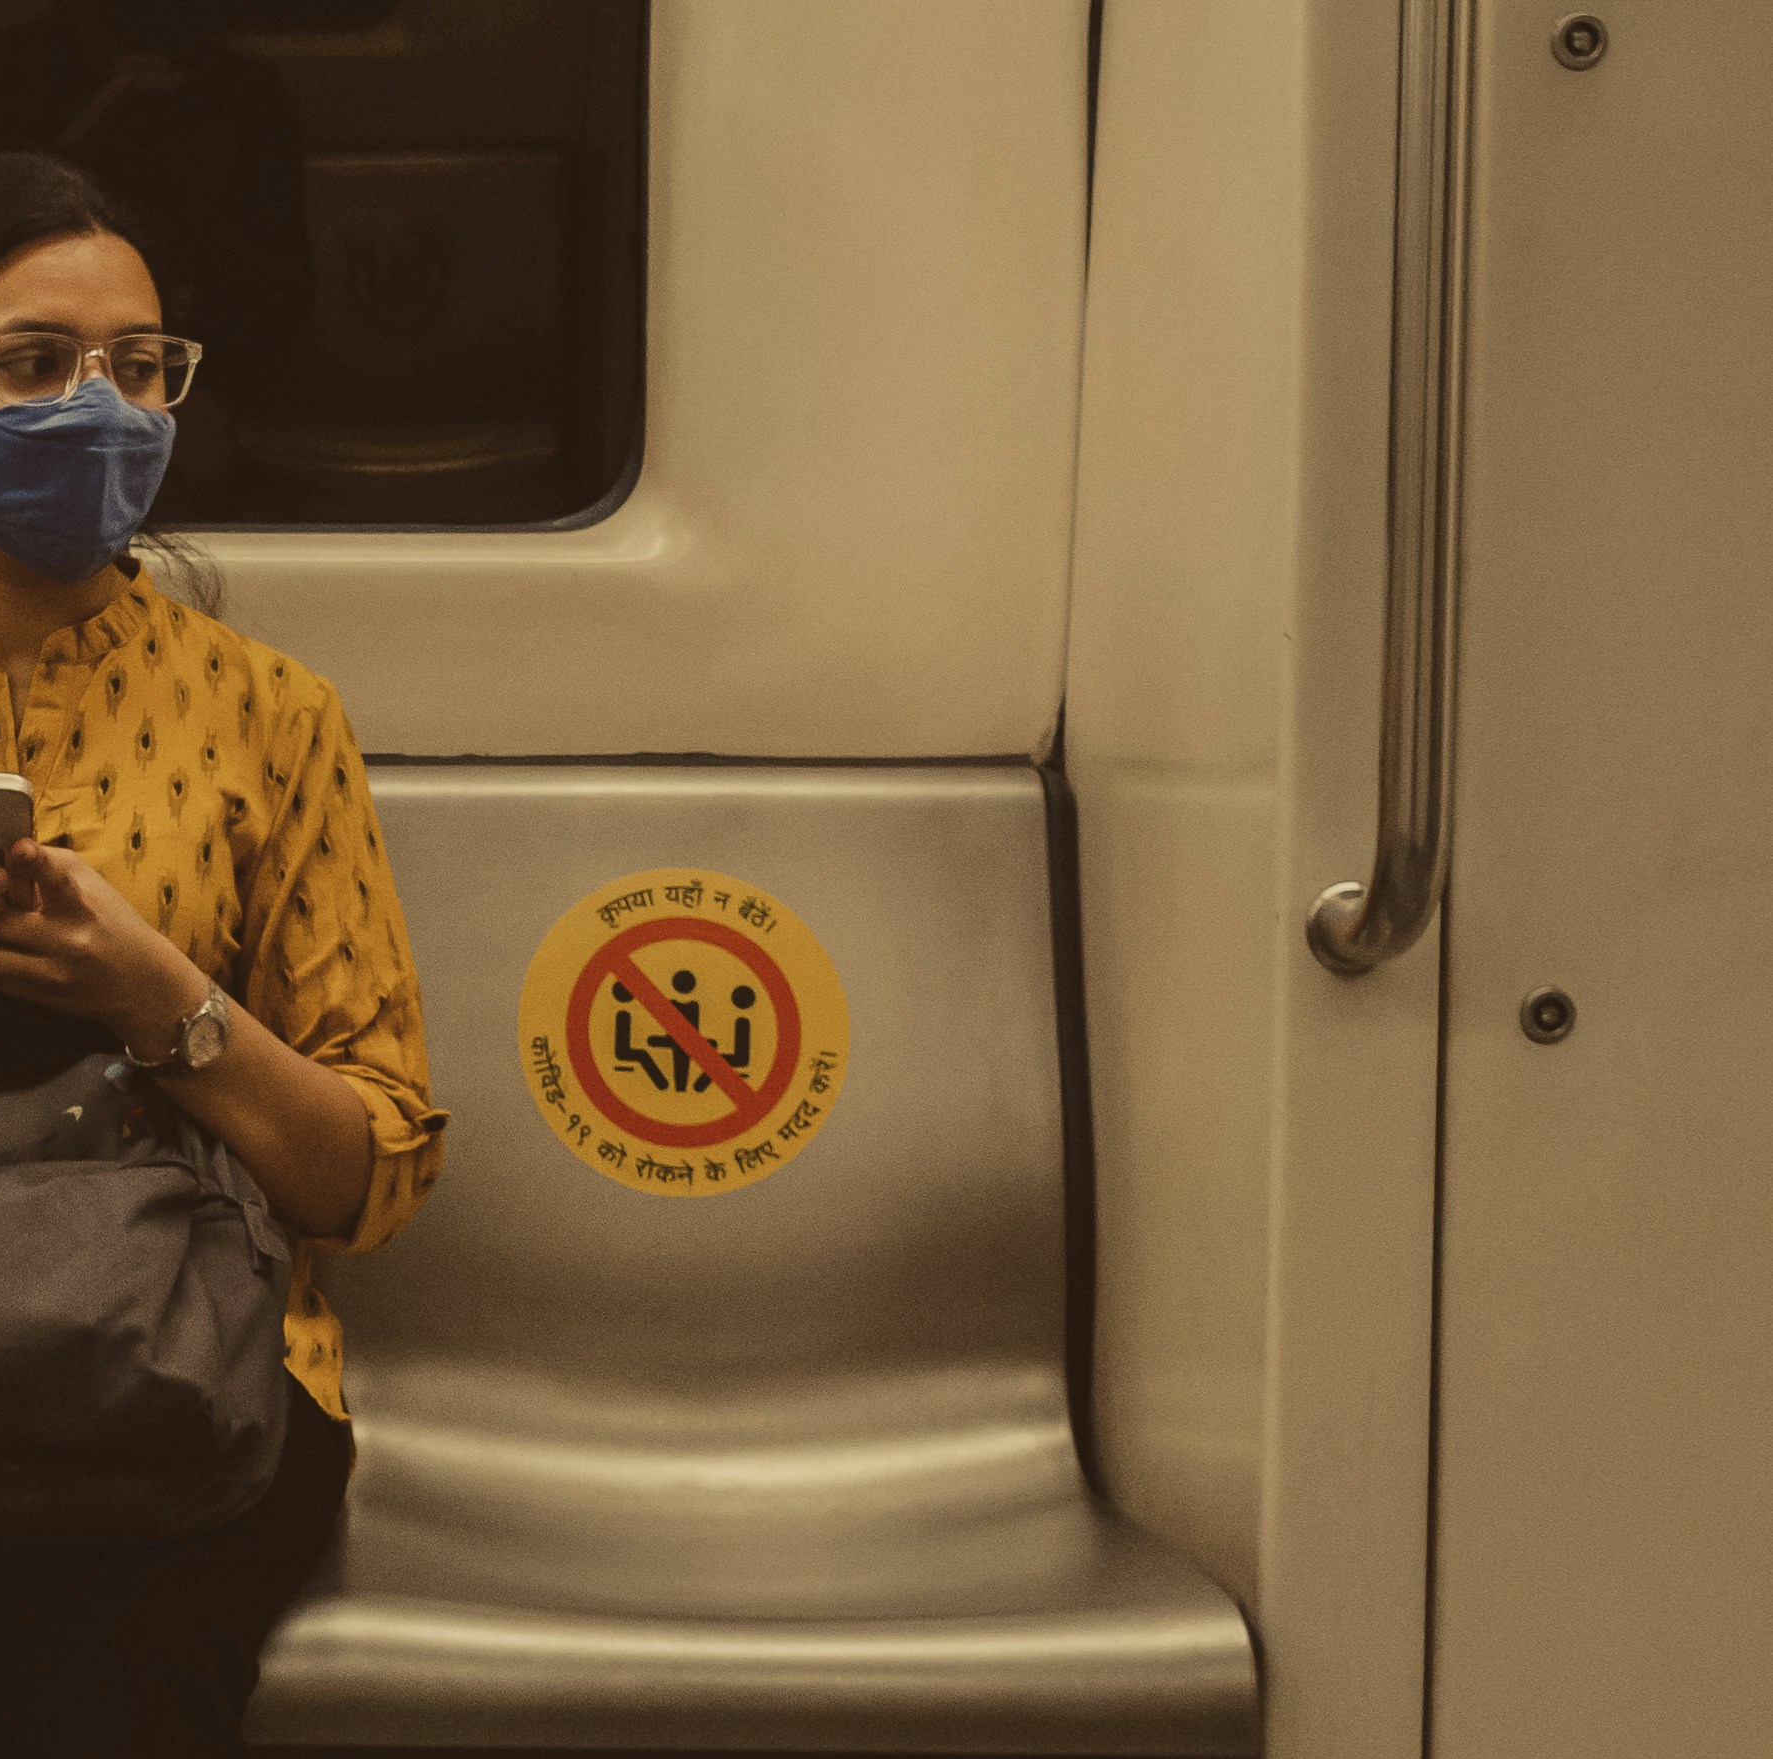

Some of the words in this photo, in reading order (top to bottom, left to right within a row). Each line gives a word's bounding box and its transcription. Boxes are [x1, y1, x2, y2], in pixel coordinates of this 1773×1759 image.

[596, 888, 655, 928] कृपया
[664, 878, 704, 909] यहाँ
[714, 891, 731, 911] न
[598, 1139, 627, 1169] को
[636, 1154, 694, 1186] रोकने
[703, 1156, 727, 1181] के
[733, 1141, 781, 1174] लिए
[777, 1098, 820, 1140] मदद
